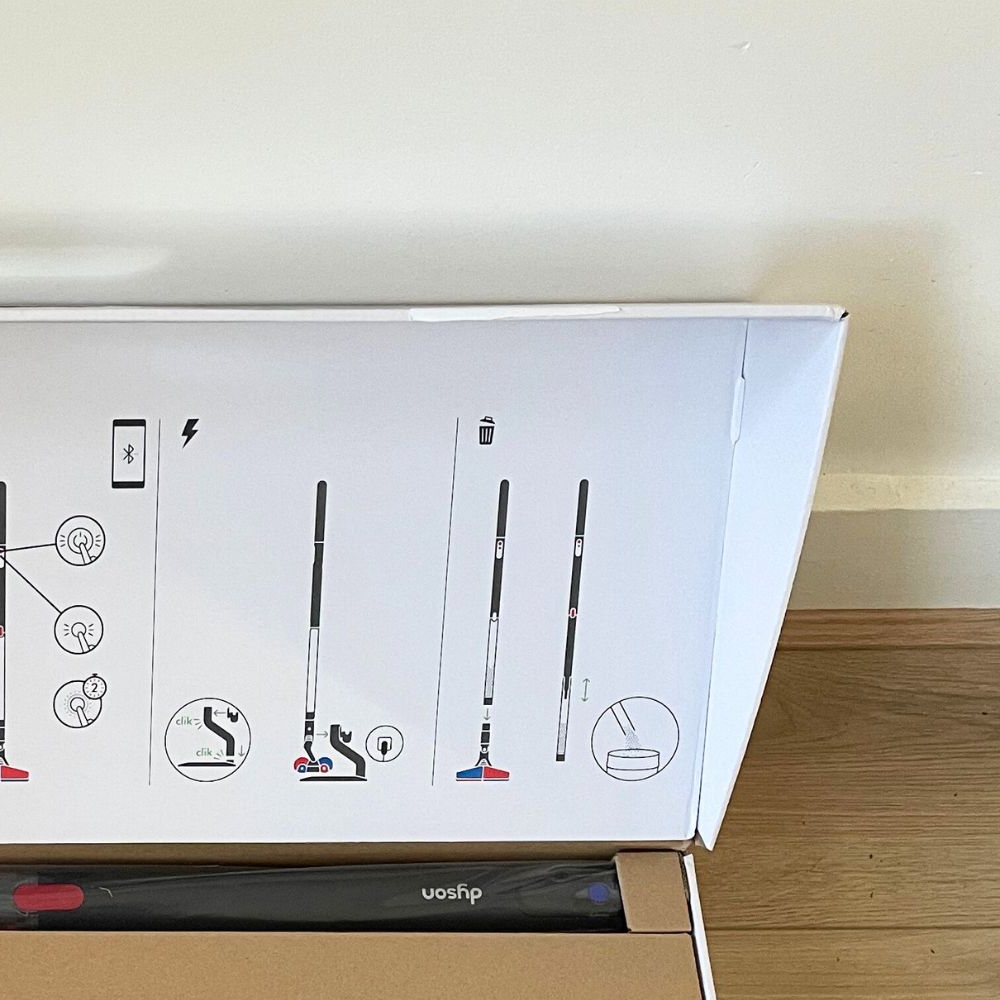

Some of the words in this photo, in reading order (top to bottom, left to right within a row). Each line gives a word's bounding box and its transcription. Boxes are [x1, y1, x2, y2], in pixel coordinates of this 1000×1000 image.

[92, 683, 98, 692] 2
[176, 716, 192, 726] clik
[196, 748, 212, 756] clik
[422, 883, 482, 905] dyson
